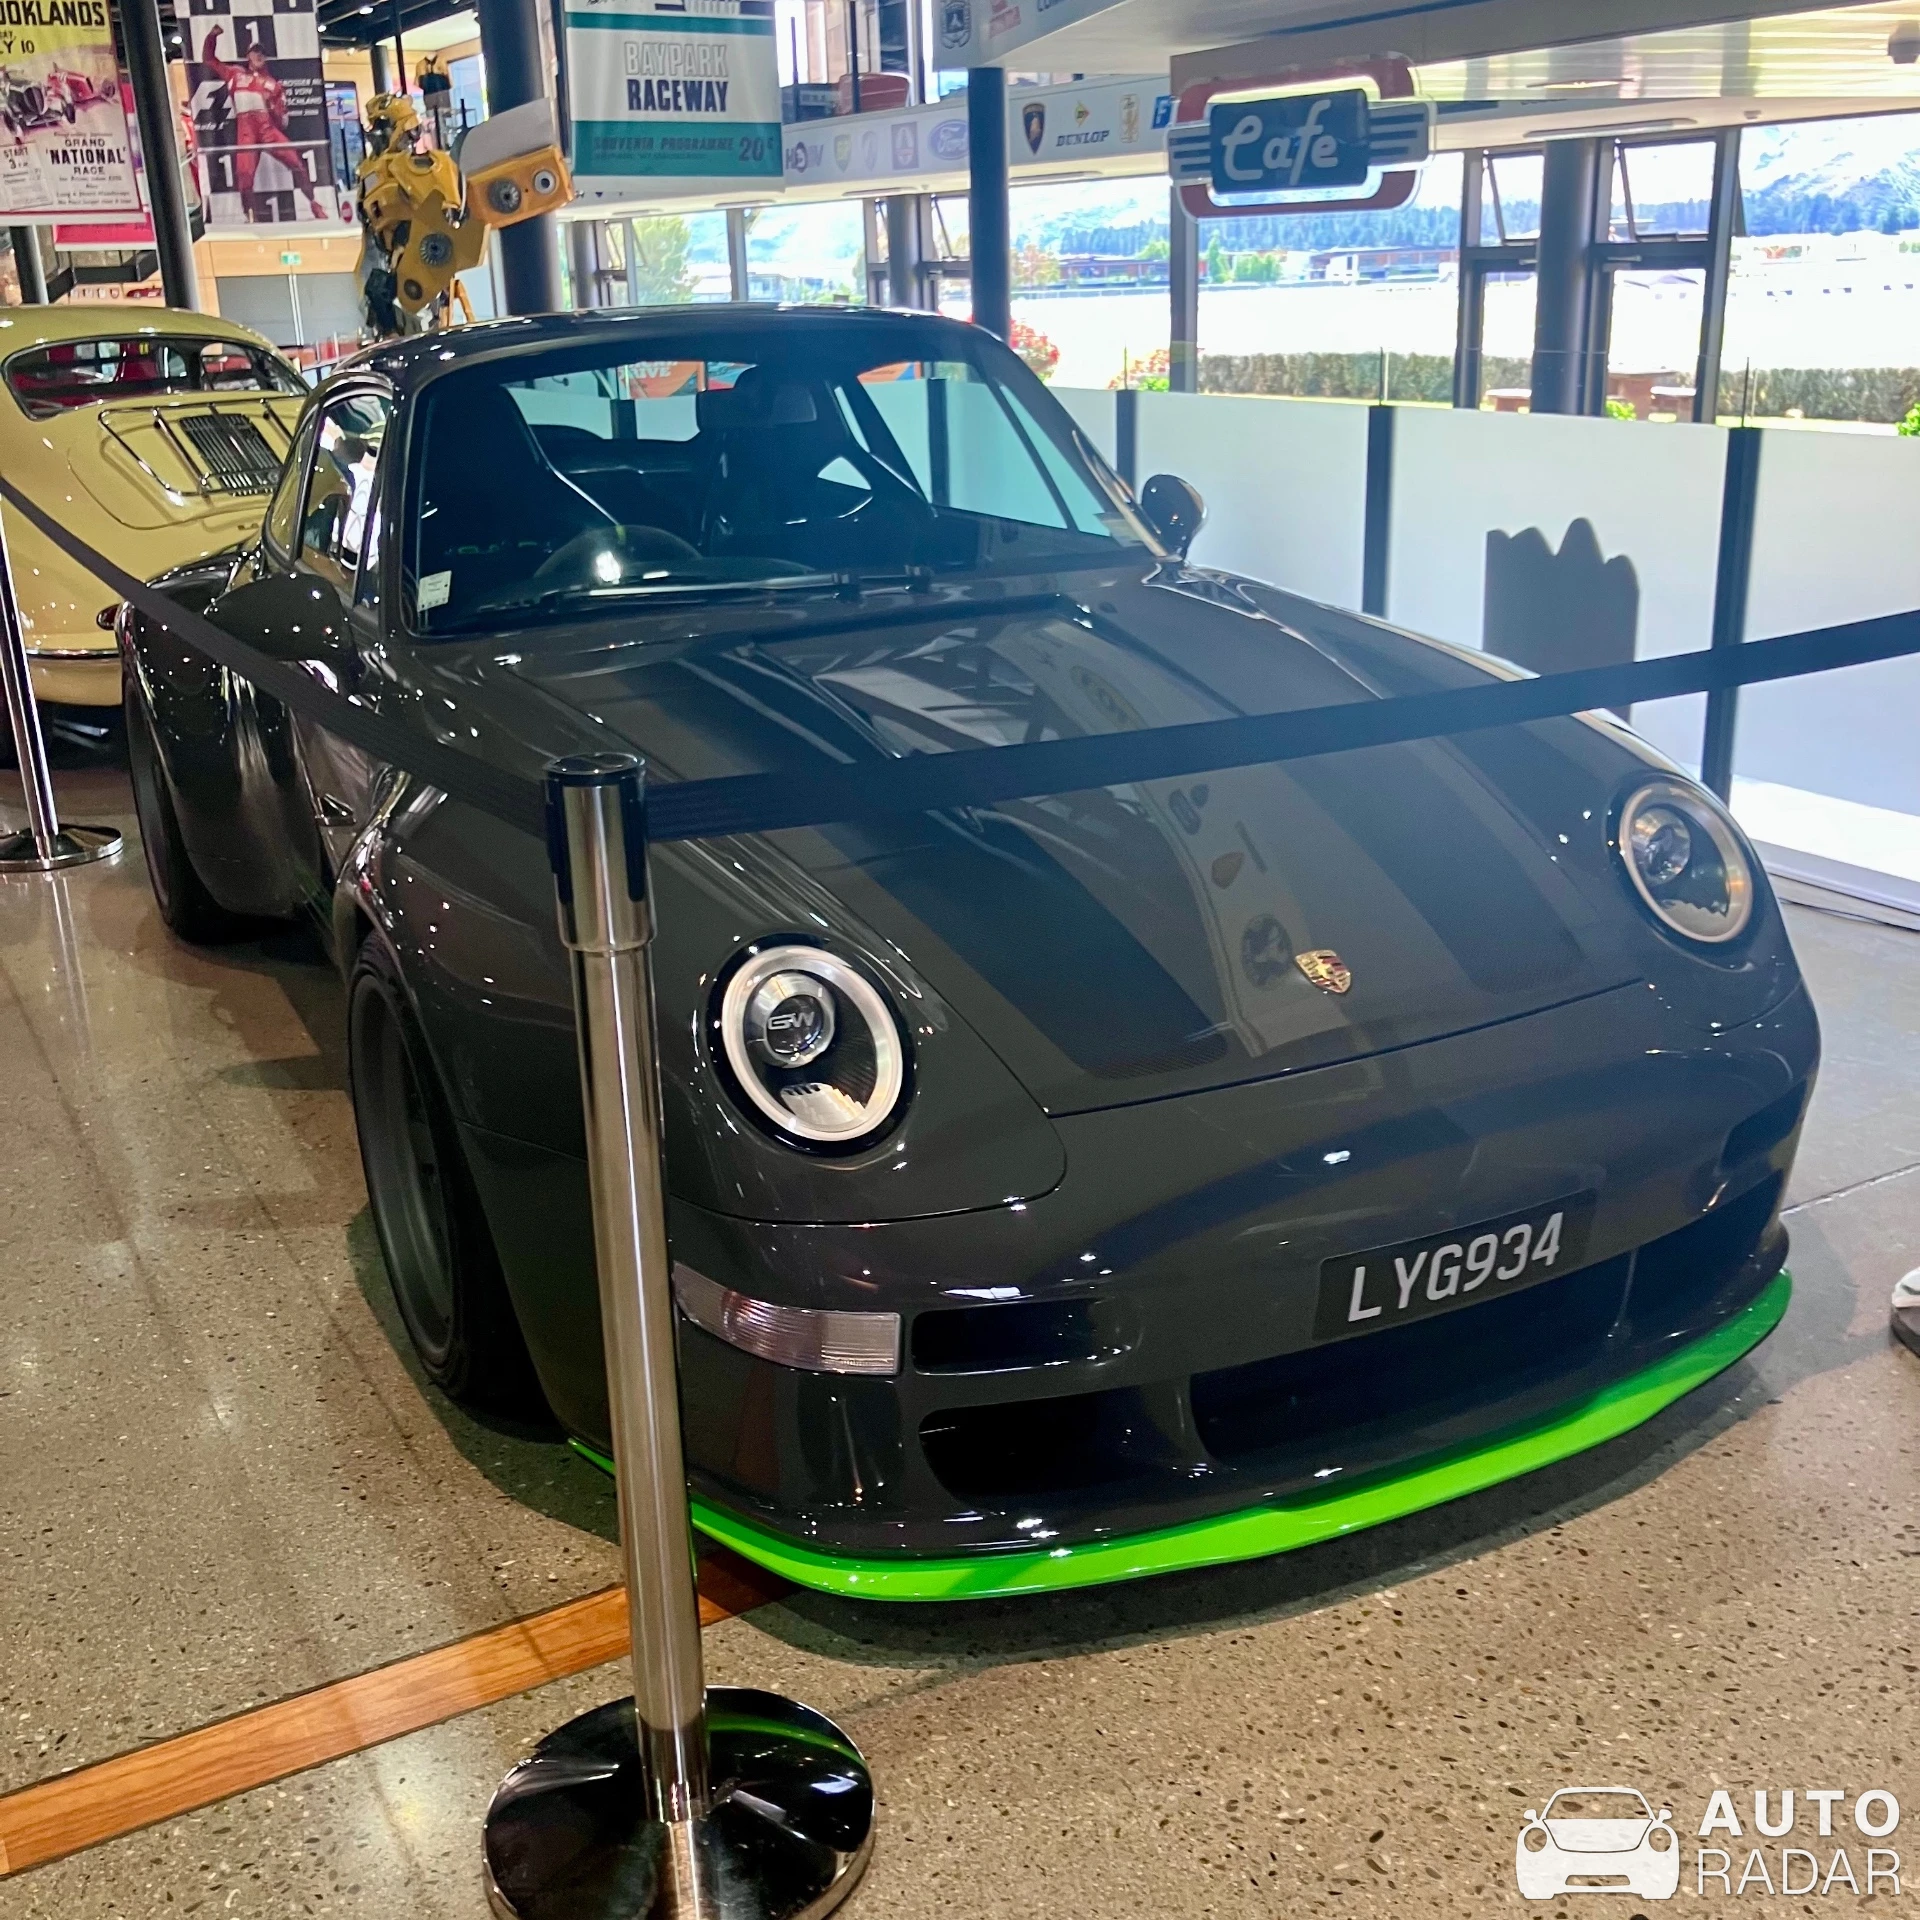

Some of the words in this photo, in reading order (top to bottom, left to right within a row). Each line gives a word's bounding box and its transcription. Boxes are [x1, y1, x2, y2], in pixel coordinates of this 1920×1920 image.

[21, 40, 35, 54] 10
[623, 41, 729, 78] BAYPARK
[626, 79, 729, 112] RACEWAY
[65, 138, 105, 147] GRAND
[659, 137, 735, 151] PROGRAMME
[1056, 130, 1110, 147] DUNLOP
[1222, 99, 1338, 185] Cafe
[3, 146, 28, 158] START
[73, 166, 105, 175] RACE
[218, 154, 233, 187] 1
[302, 149, 317, 183] 1
[265, 196, 280, 222] 1
[768, 1011, 815, 1030] GW
[1348, 1211, 1564, 1323] LYG934
